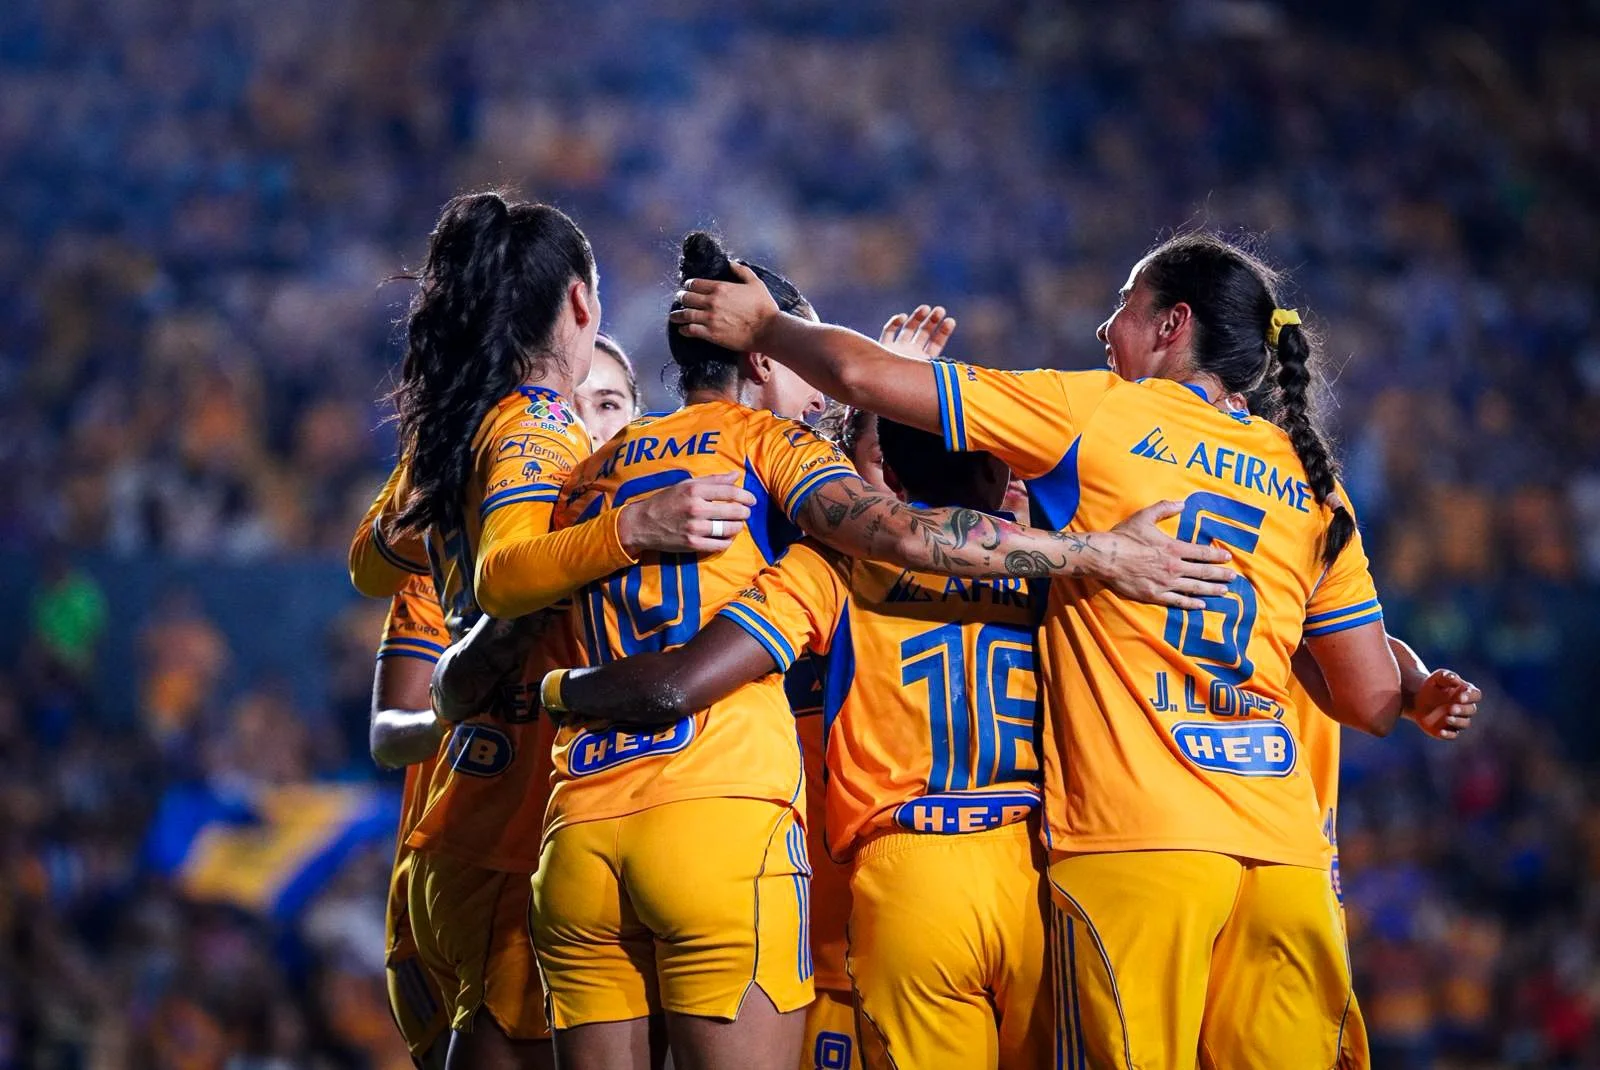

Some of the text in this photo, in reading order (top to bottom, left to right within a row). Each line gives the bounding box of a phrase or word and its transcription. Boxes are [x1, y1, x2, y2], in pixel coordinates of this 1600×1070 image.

[541, 422, 568, 436] BBVA
[529, 441, 571, 472] Ternium
[1185, 441, 1312, 514] AFIRME
[942, 575, 1031, 608] AFIR
[1149, 671, 1178, 712] J.
[1184, 735, 1287, 763] H-E-B
